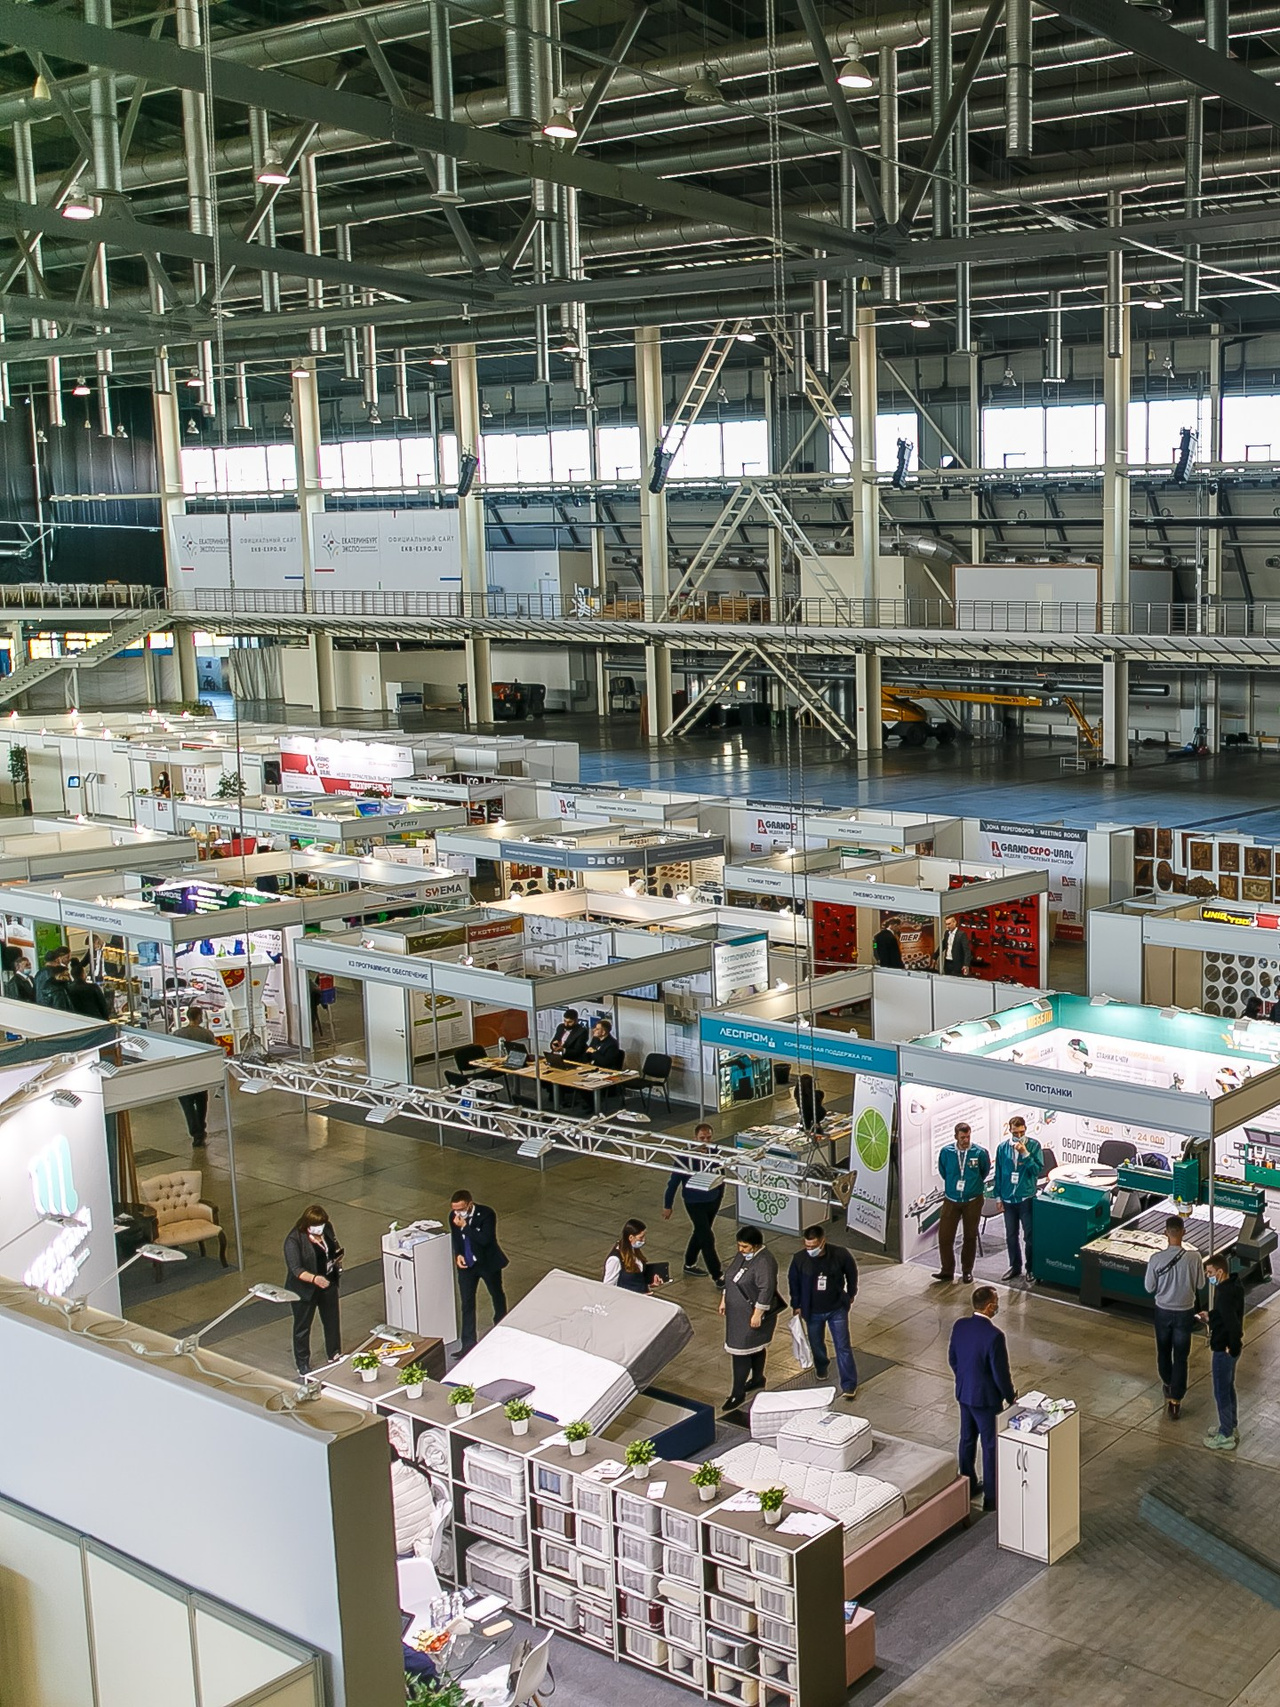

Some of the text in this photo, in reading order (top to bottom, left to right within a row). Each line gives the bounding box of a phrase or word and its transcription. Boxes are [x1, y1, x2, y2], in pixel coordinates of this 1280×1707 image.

[198, 537, 231, 545] ЕКАТЕРИНБУР
[341, 536, 378, 545] ЕКАТЕРИНБУРГ
[388, 535, 436, 543] ОФИЦИАЛЬНЫЙ
[342, 545, 360, 553] ЭКСПО
[986, 823, 1000, 831] ЗОНА
[1000, 825, 1035, 835] ПЕРЕГОВОРОВ
[1040, 829, 1062, 837] MEETING
[747, 877, 764, 885] СТАНКИ
[853, 891, 896, 902] ПНЕВМО-ЭЛЕКТРО
[355, 961, 391, 974] ПРОГРАММНОЕ
[392, 967, 429, 981] ОБЕСПЕЧЕНИЕ
[1027, 1009, 1053, 1029] МЕБЕЛИ
[719, 1027, 768, 1043] ЛЕСПРОМ
[824, 1047, 860, 1060] ПОДДЕРЖКА
[861, 1053, 873, 1062] ЛПК
[1096, 1051, 1115, 1061] СТАНКИ
[1025, 1082, 1073, 1098] ТОПСТАНКИ
[1137, 1132, 1148, 1142] 24
